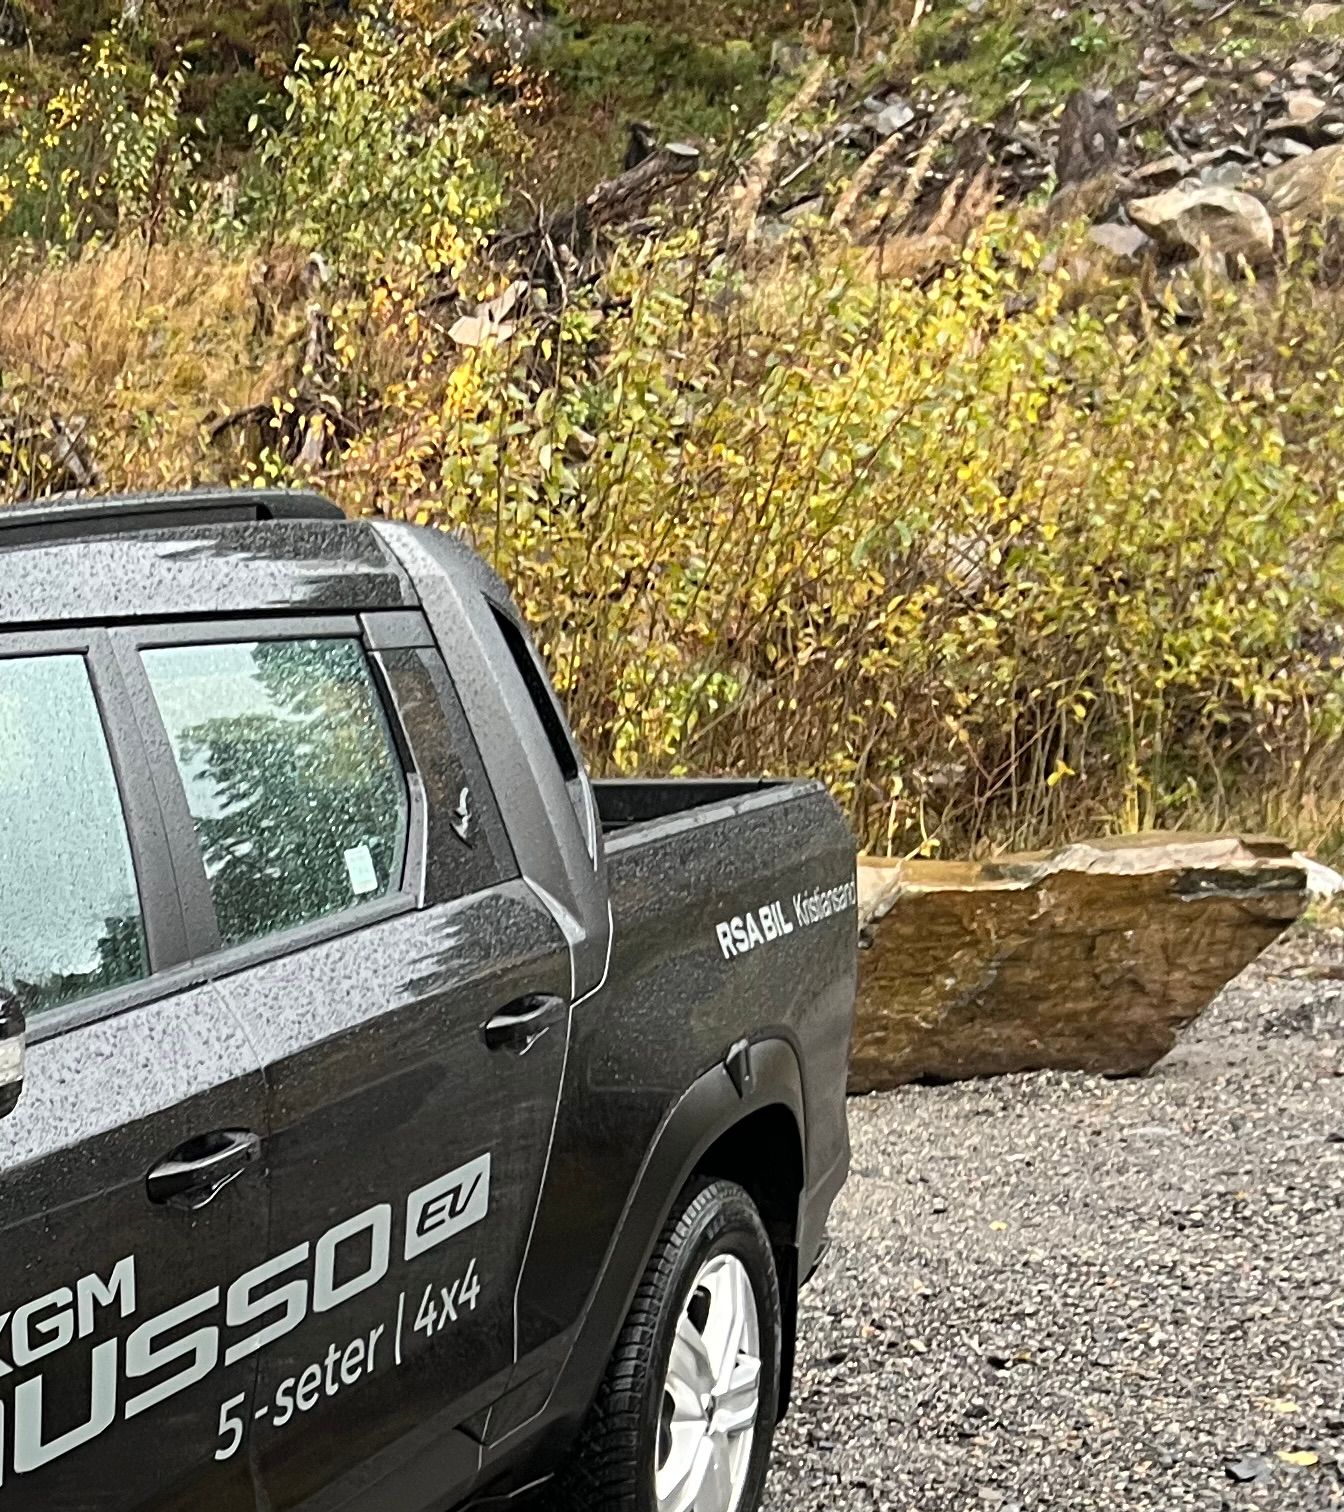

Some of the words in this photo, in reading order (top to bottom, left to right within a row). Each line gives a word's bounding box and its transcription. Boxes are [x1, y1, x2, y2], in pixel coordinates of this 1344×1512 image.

[716, 912, 764, 960] RSA
[758, 900, 794, 942] BIL
[214, 1322, 383, 1462] 5-seter
[413, 1257, 481, 1338] 4x4
